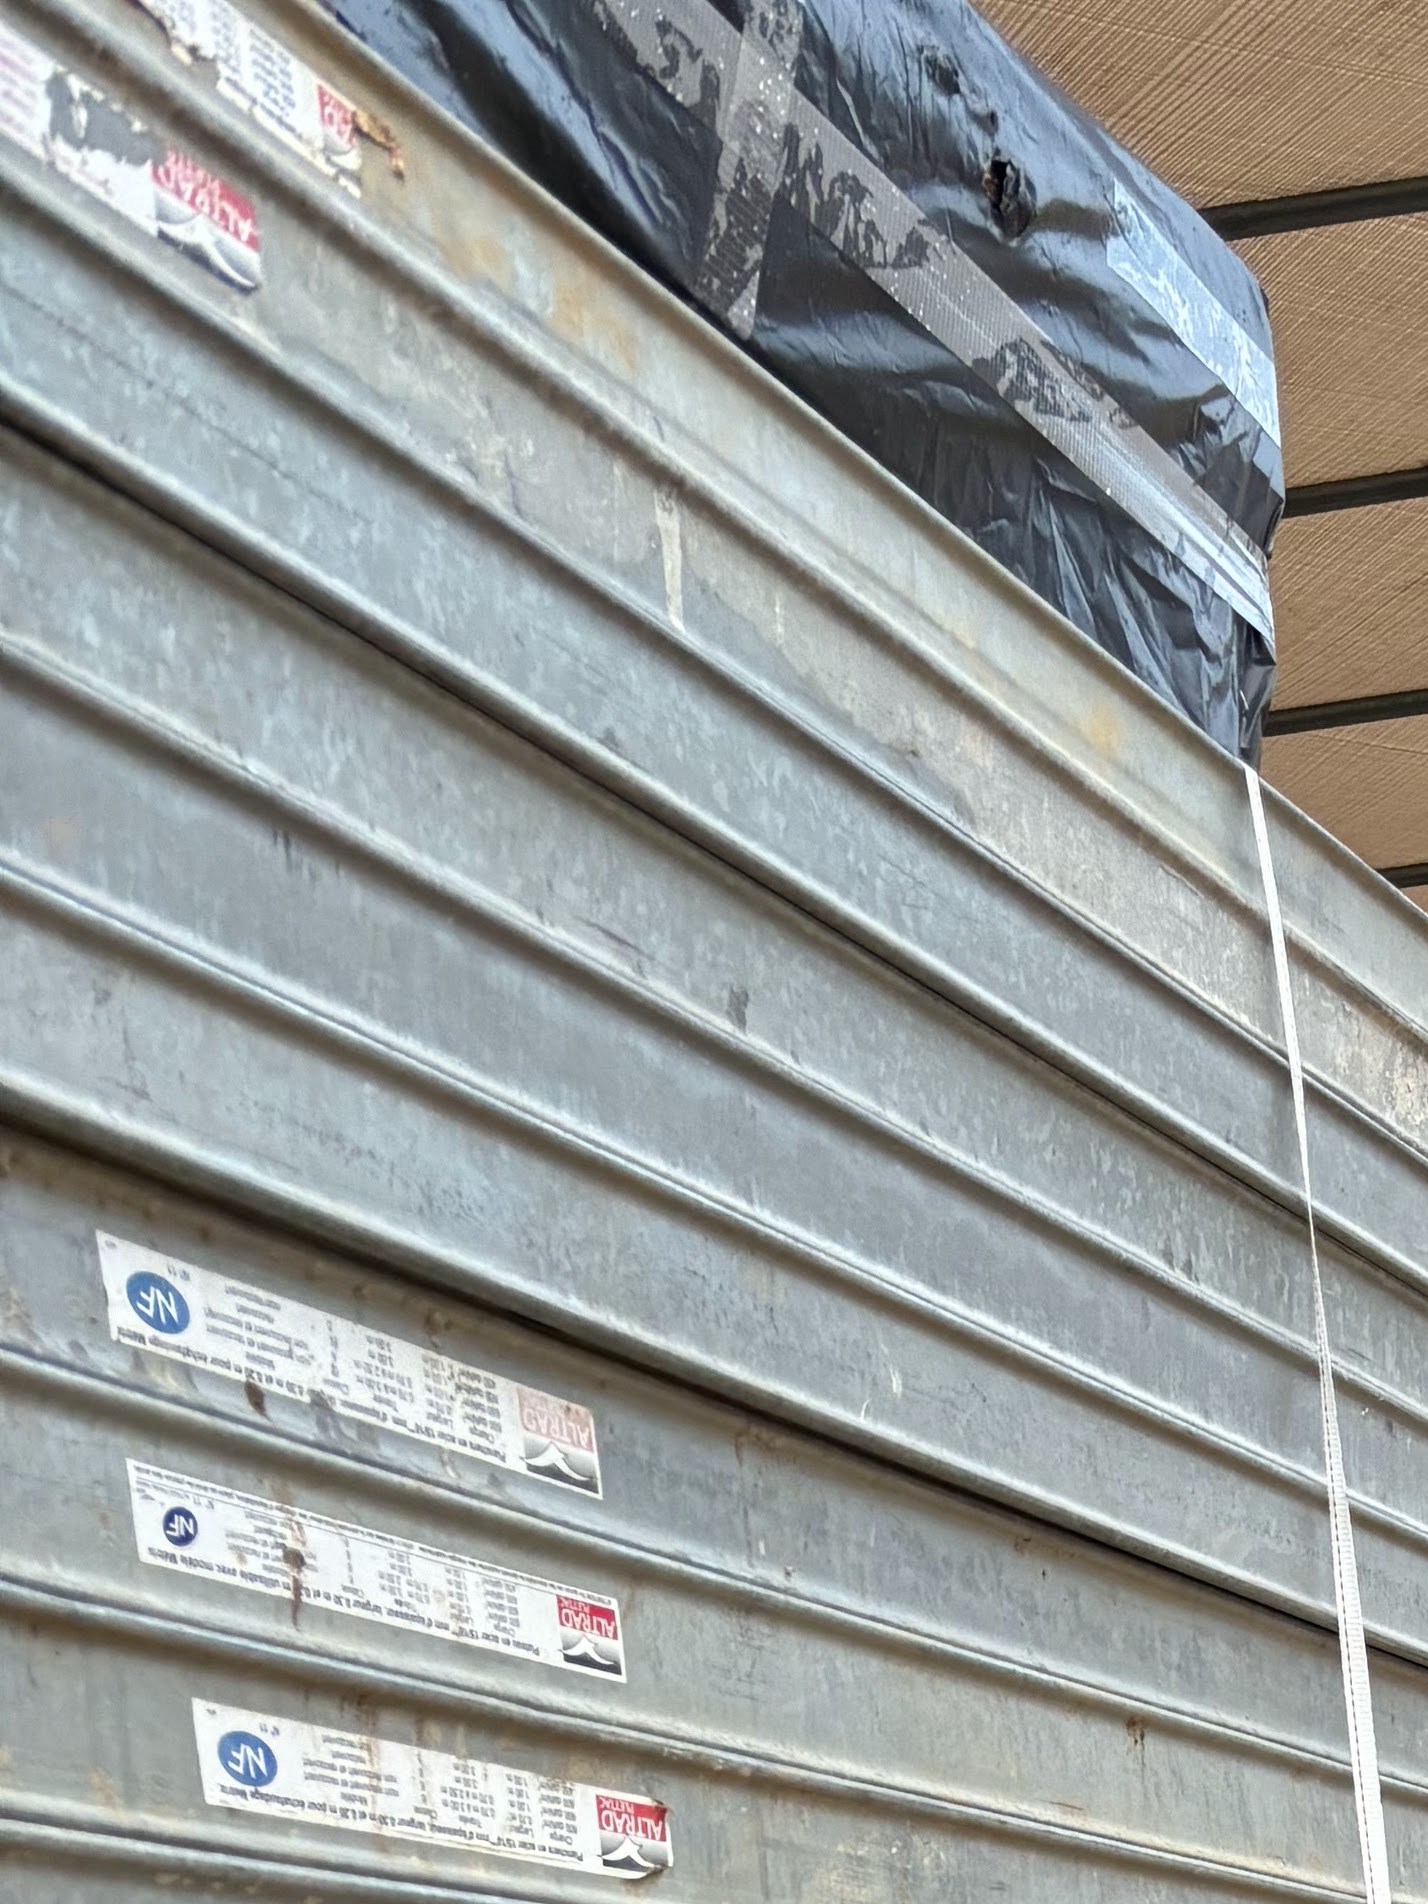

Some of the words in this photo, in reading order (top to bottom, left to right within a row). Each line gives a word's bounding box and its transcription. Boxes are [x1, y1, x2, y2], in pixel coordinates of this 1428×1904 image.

[132, 1278, 179, 1329] NF
[520, 1403, 591, 1450] ALTRAD
[163, 1510, 196, 1540] NF
[560, 1606, 616, 1638] ALTRAD
[225, 1739, 268, 1780] NF
[600, 1807, 663, 1840] ALTRAD
